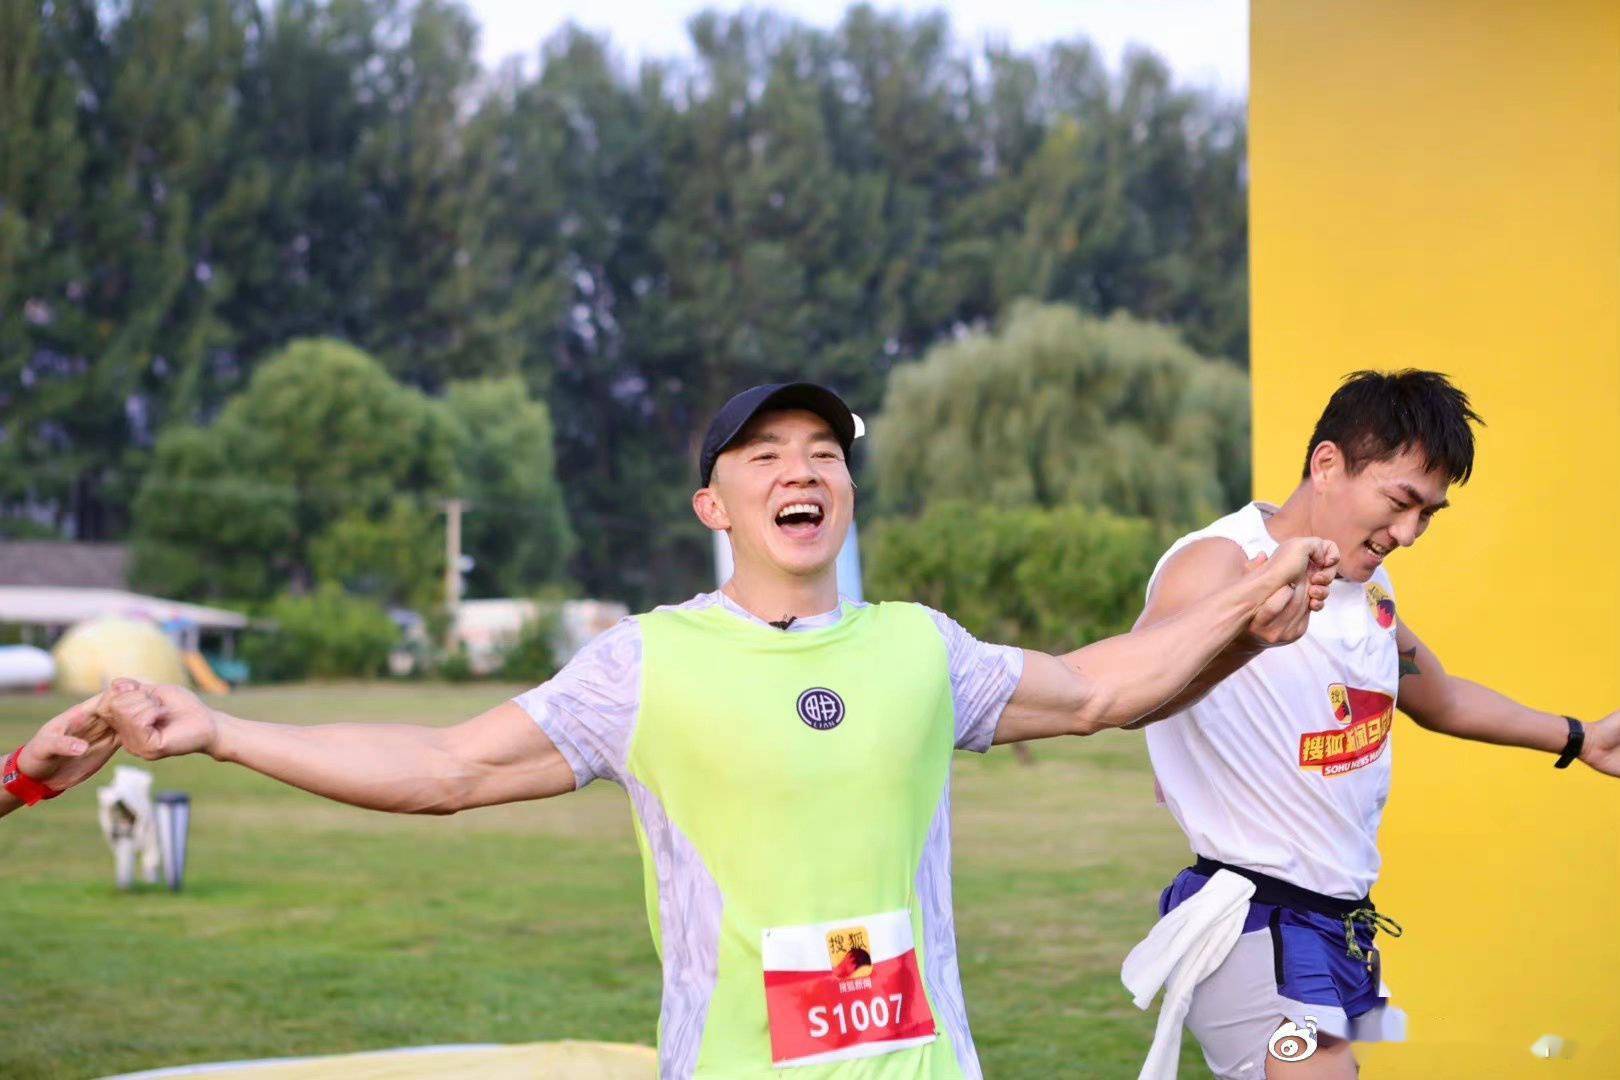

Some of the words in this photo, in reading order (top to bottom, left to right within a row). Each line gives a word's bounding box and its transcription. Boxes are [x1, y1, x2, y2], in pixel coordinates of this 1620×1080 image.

[1325, 763, 1351, 775] SOHU
[828, 931, 867, 954] 搜狐
[807, 992, 903, 1038] S1007
